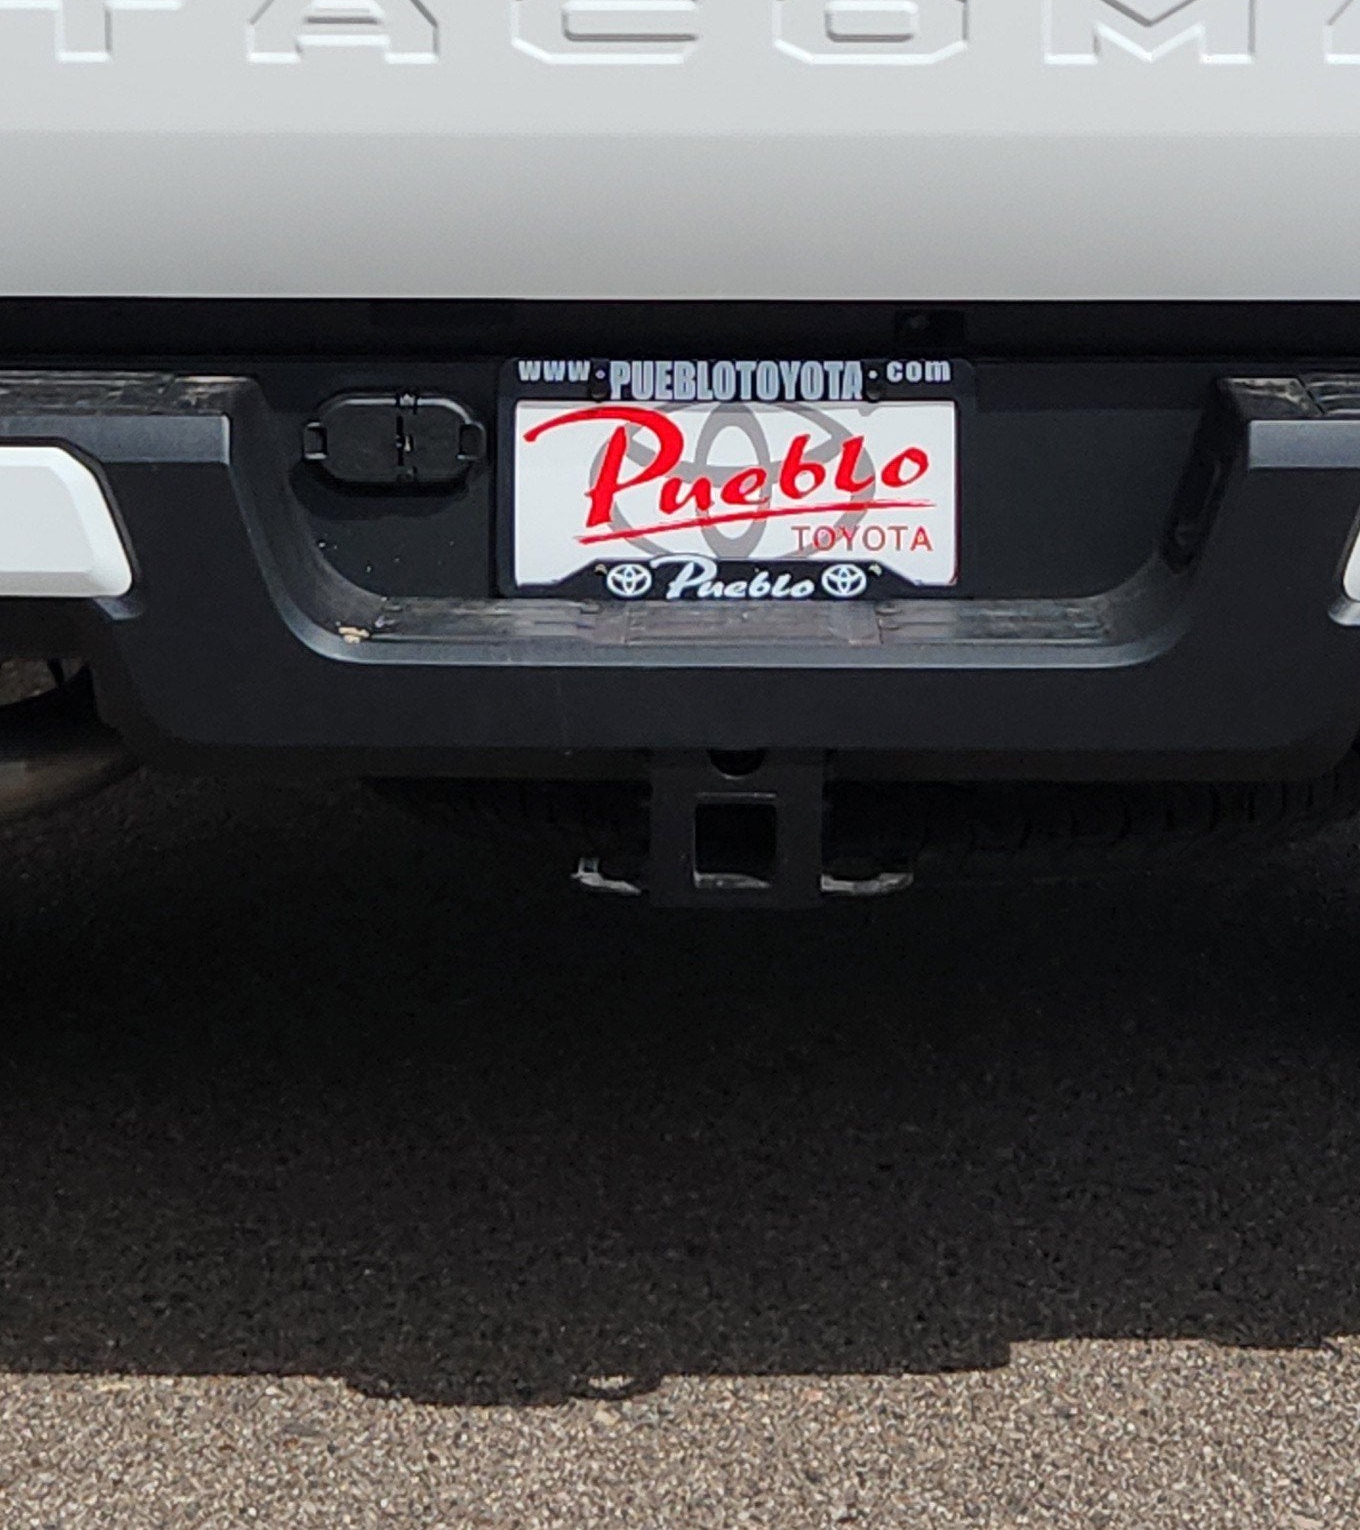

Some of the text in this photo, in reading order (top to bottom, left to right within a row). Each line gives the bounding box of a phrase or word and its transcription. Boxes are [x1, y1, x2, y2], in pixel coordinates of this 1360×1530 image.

[523, 406, 929, 527] Pueblo
[791, 525, 933, 552] TOYOTA
[651, 553, 816, 600] Pueblo
